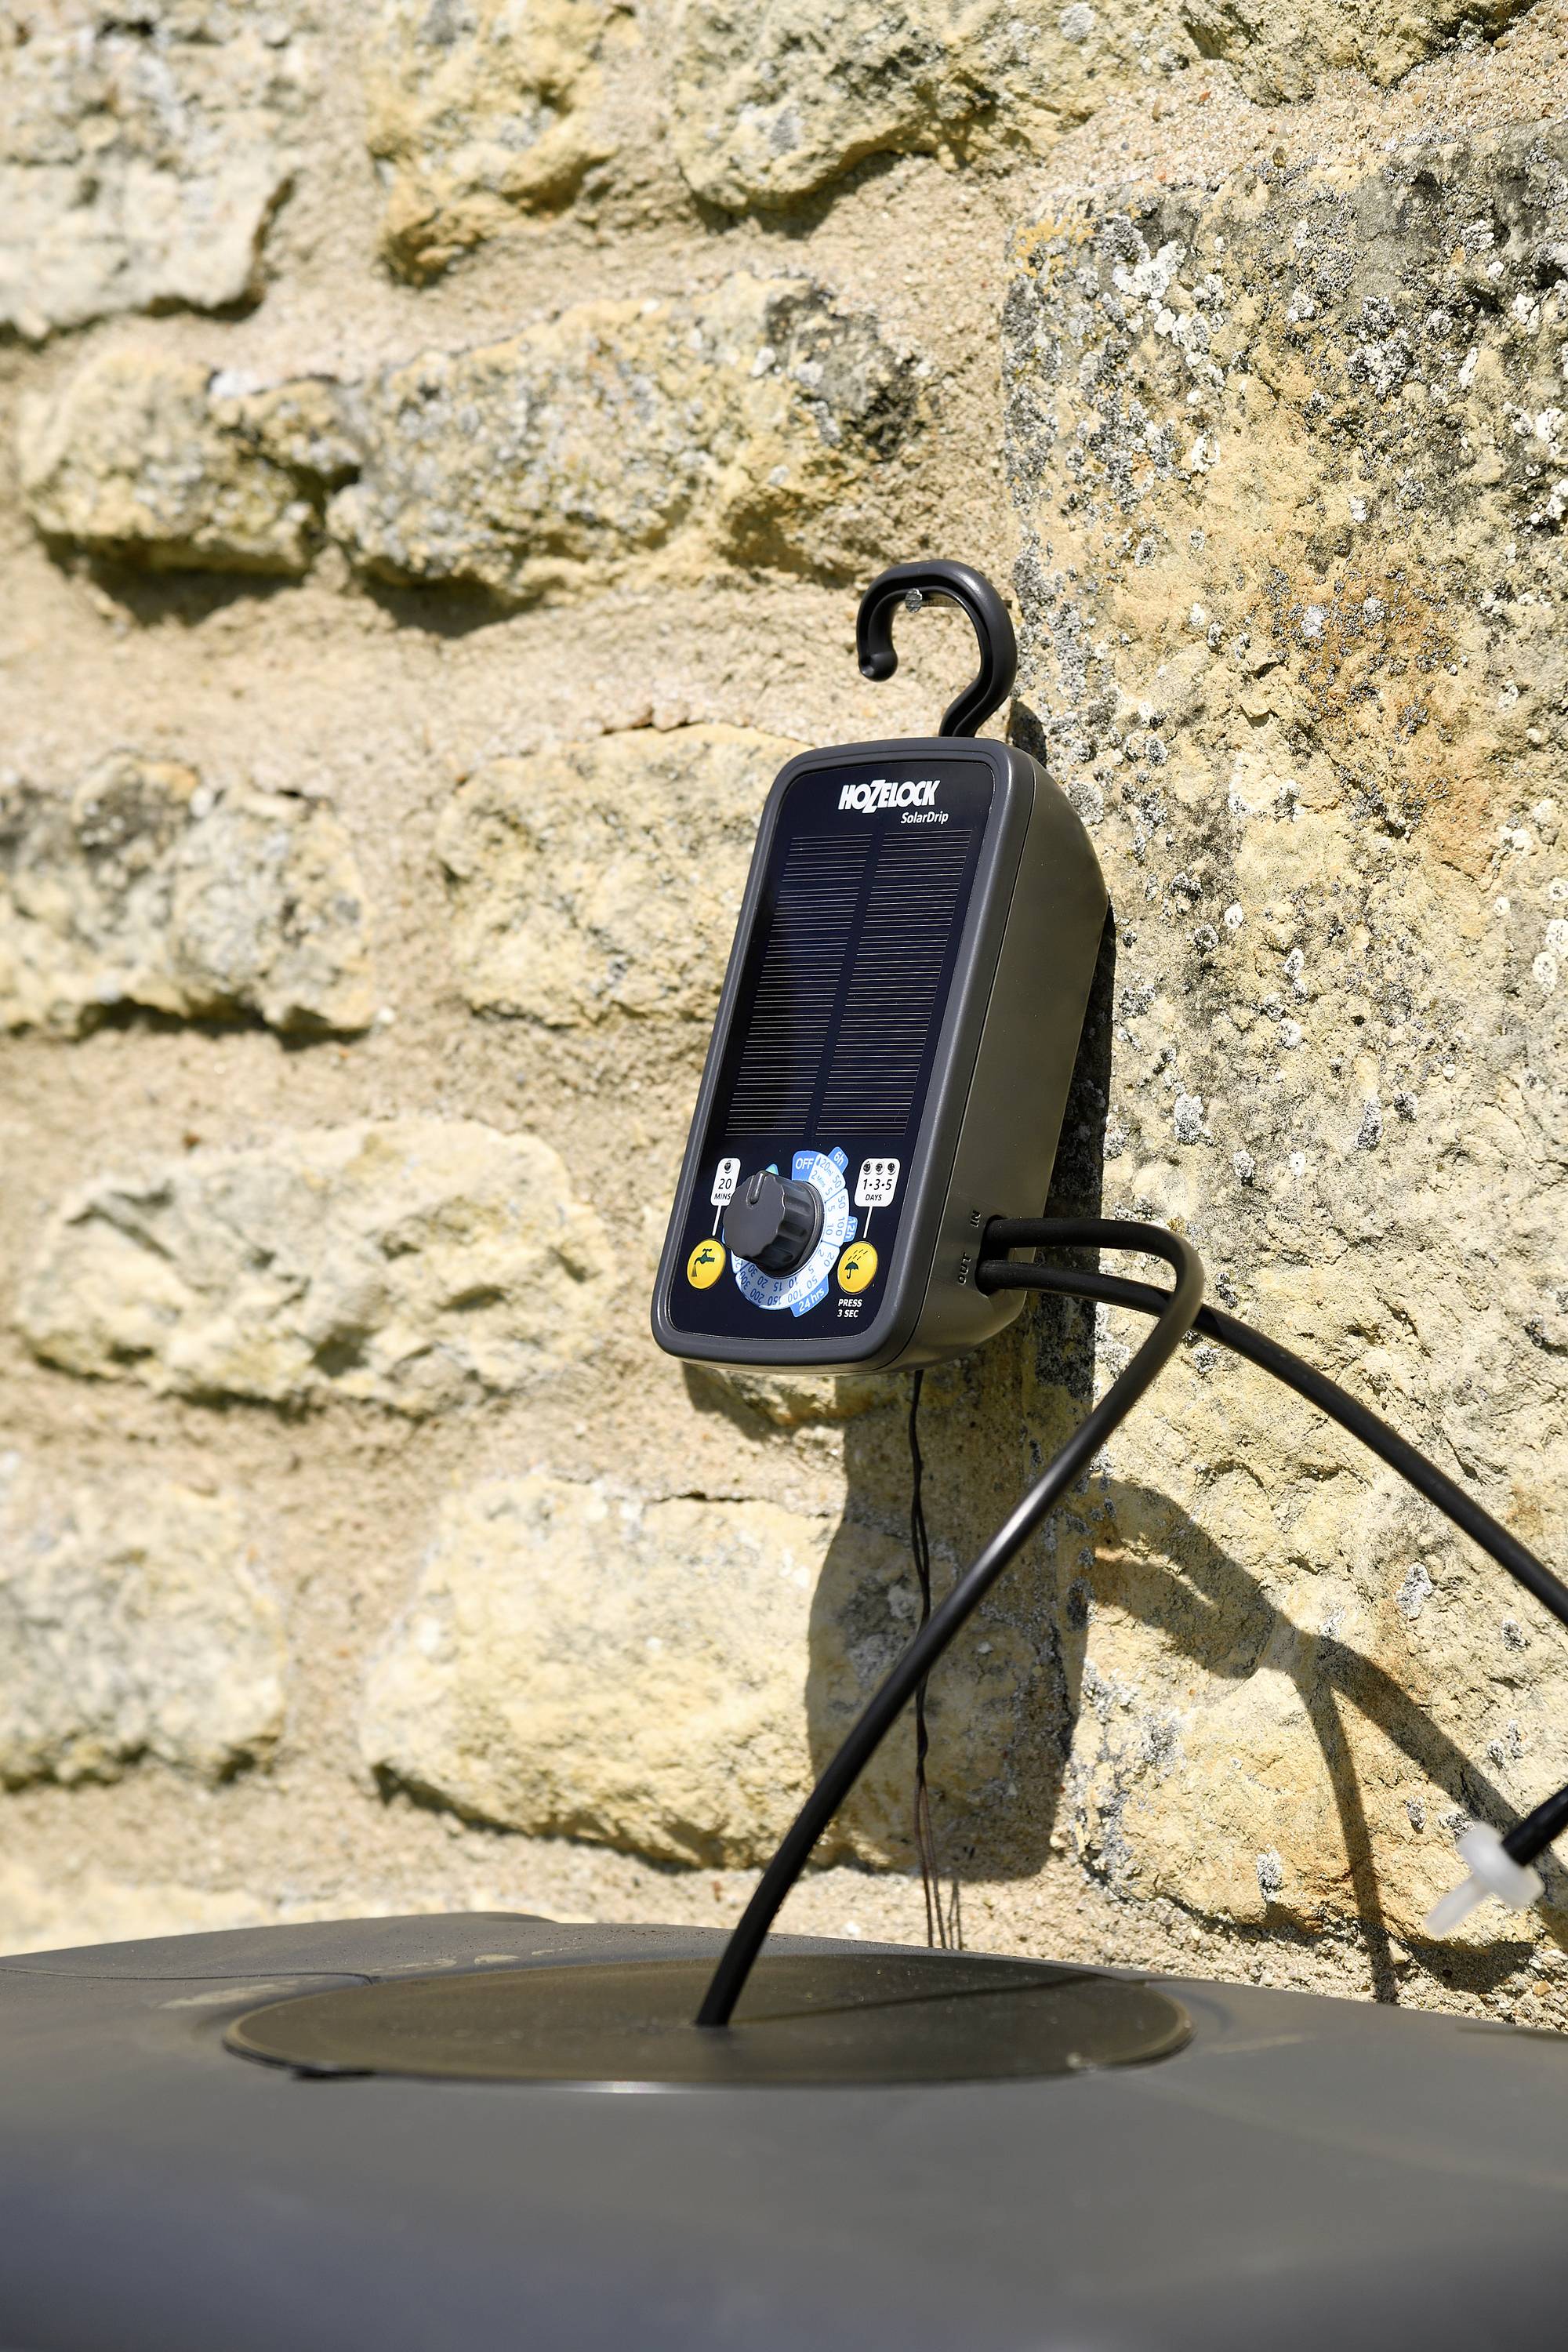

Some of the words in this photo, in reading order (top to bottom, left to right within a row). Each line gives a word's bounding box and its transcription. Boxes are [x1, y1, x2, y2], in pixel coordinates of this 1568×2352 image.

[838, 780, 940, 813] HOZELOCK
[901, 811, 949, 824] SolarDrip
[795, 1157, 815, 1170] OFF
[833, 1151, 844, 1167] 6h
[718, 1178, 731, 1189] 20
[832, 1174, 842, 1189] 50
[825, 1187, 833, 1196] 5
[837, 1195, 845, 1209] 50
[835, 1216, 845, 1236] 100
[970, 1210, 981, 1228] IN
[826, 1223, 834, 1236] 10
[845, 1218, 855, 1241] 12h
[824, 1252, 835, 1267] 20
[748, 1264, 758, 1277] 30
[957, 1251, 971, 1285] OUT
[739, 1271, 751, 1290] 300
[757, 1276, 768, 1289] 20
[773, 1281, 783, 1292] 15
[788, 1276, 798, 1289] 10
[806, 1275, 818, 1289] 50
[750, 1288, 764, 1303] 200
[767, 1296, 781, 1306] 150
[787, 1289, 803, 1303] 100
[799, 1298, 811, 1312] 24
[811, 1287, 825, 1304] hrs
[838, 1298, 862, 1307] PRESS
[844, 1309, 859, 1318] SEC
